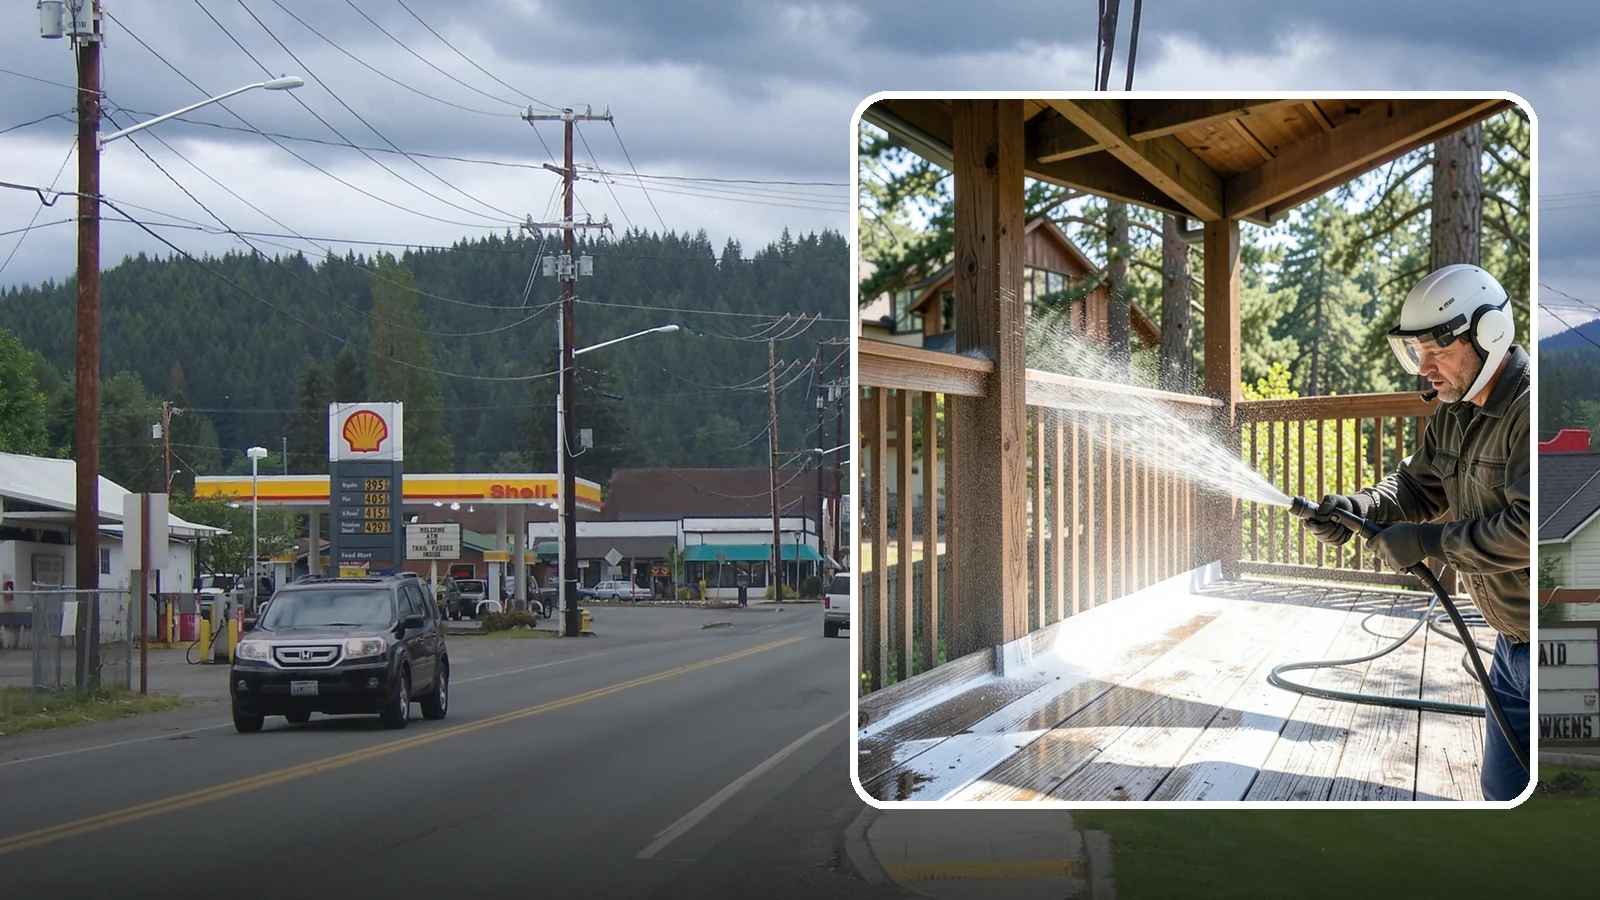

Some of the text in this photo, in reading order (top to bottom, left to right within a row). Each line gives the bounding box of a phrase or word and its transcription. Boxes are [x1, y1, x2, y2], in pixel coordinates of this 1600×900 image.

[366, 480, 383, 490] 395
[490, 484, 547, 499] Shell
[366, 494, 383, 504] 405
[366, 508, 383, 518] 415
[366, 522, 383, 533] 429
